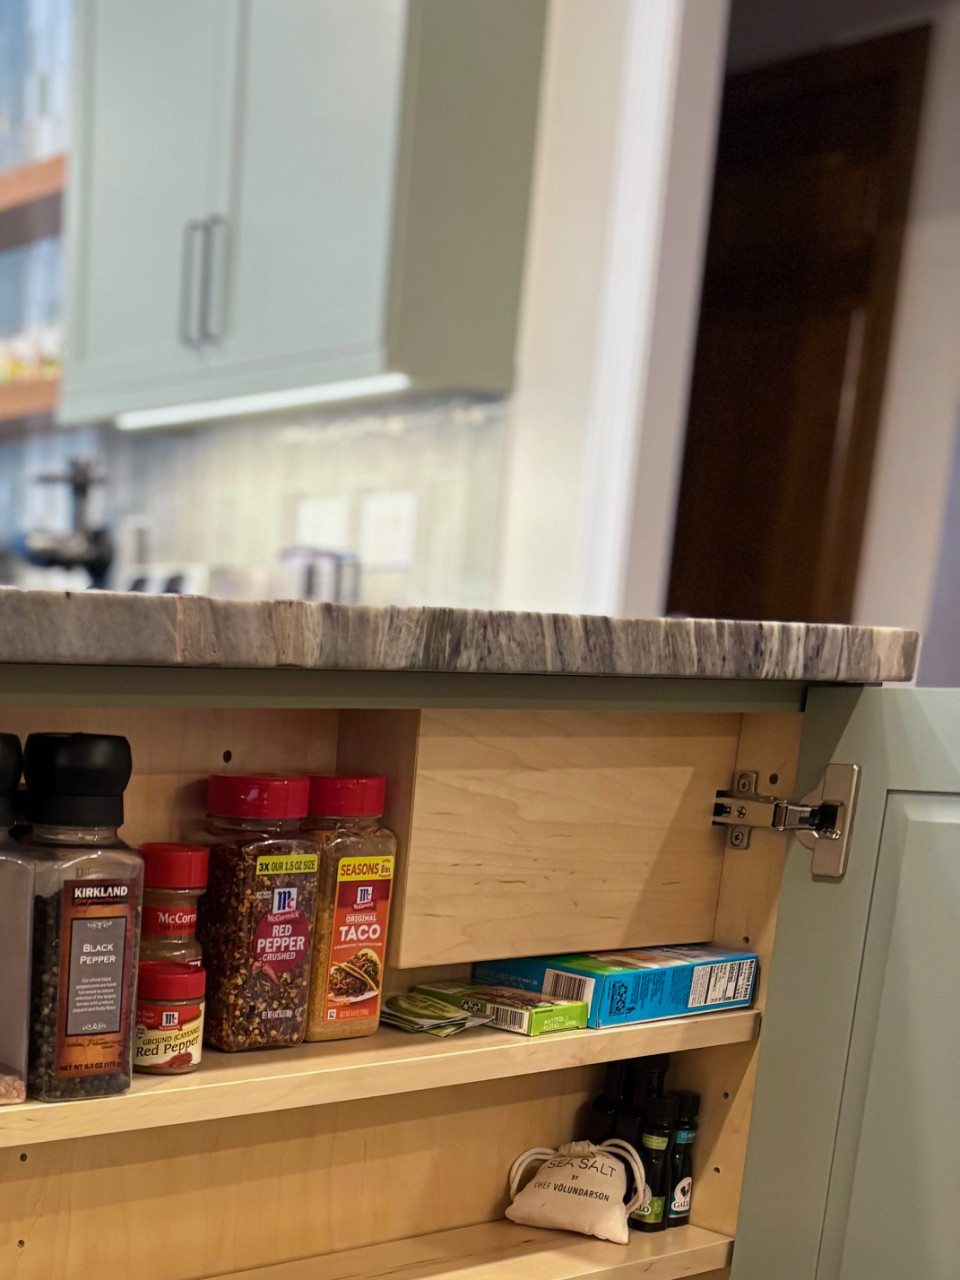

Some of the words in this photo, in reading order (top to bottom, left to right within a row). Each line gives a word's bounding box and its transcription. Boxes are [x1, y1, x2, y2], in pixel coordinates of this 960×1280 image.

[258, 862, 269, 872] 3X
[271, 861, 284, 872] OUR
[294, 860, 302, 871] OZ
[303, 859, 316, 870] SIZE
[340, 862, 380, 876] SEASONS
[74, 885, 128, 898] KIRKLAND
[272, 924, 293, 937] RED
[339, 924, 381, 942] TACO
[257, 936, 306, 954] PEPPER
[262, 951, 296, 962] CRUSHED
[136, 1045, 159, 1058] Red
[163, 1035, 200, 1055] Pepper
[142, 1036, 172, 1046] GROUND
[547, 1157, 575, 1169] SEA
[578, 1157, 617, 1178] SALT
